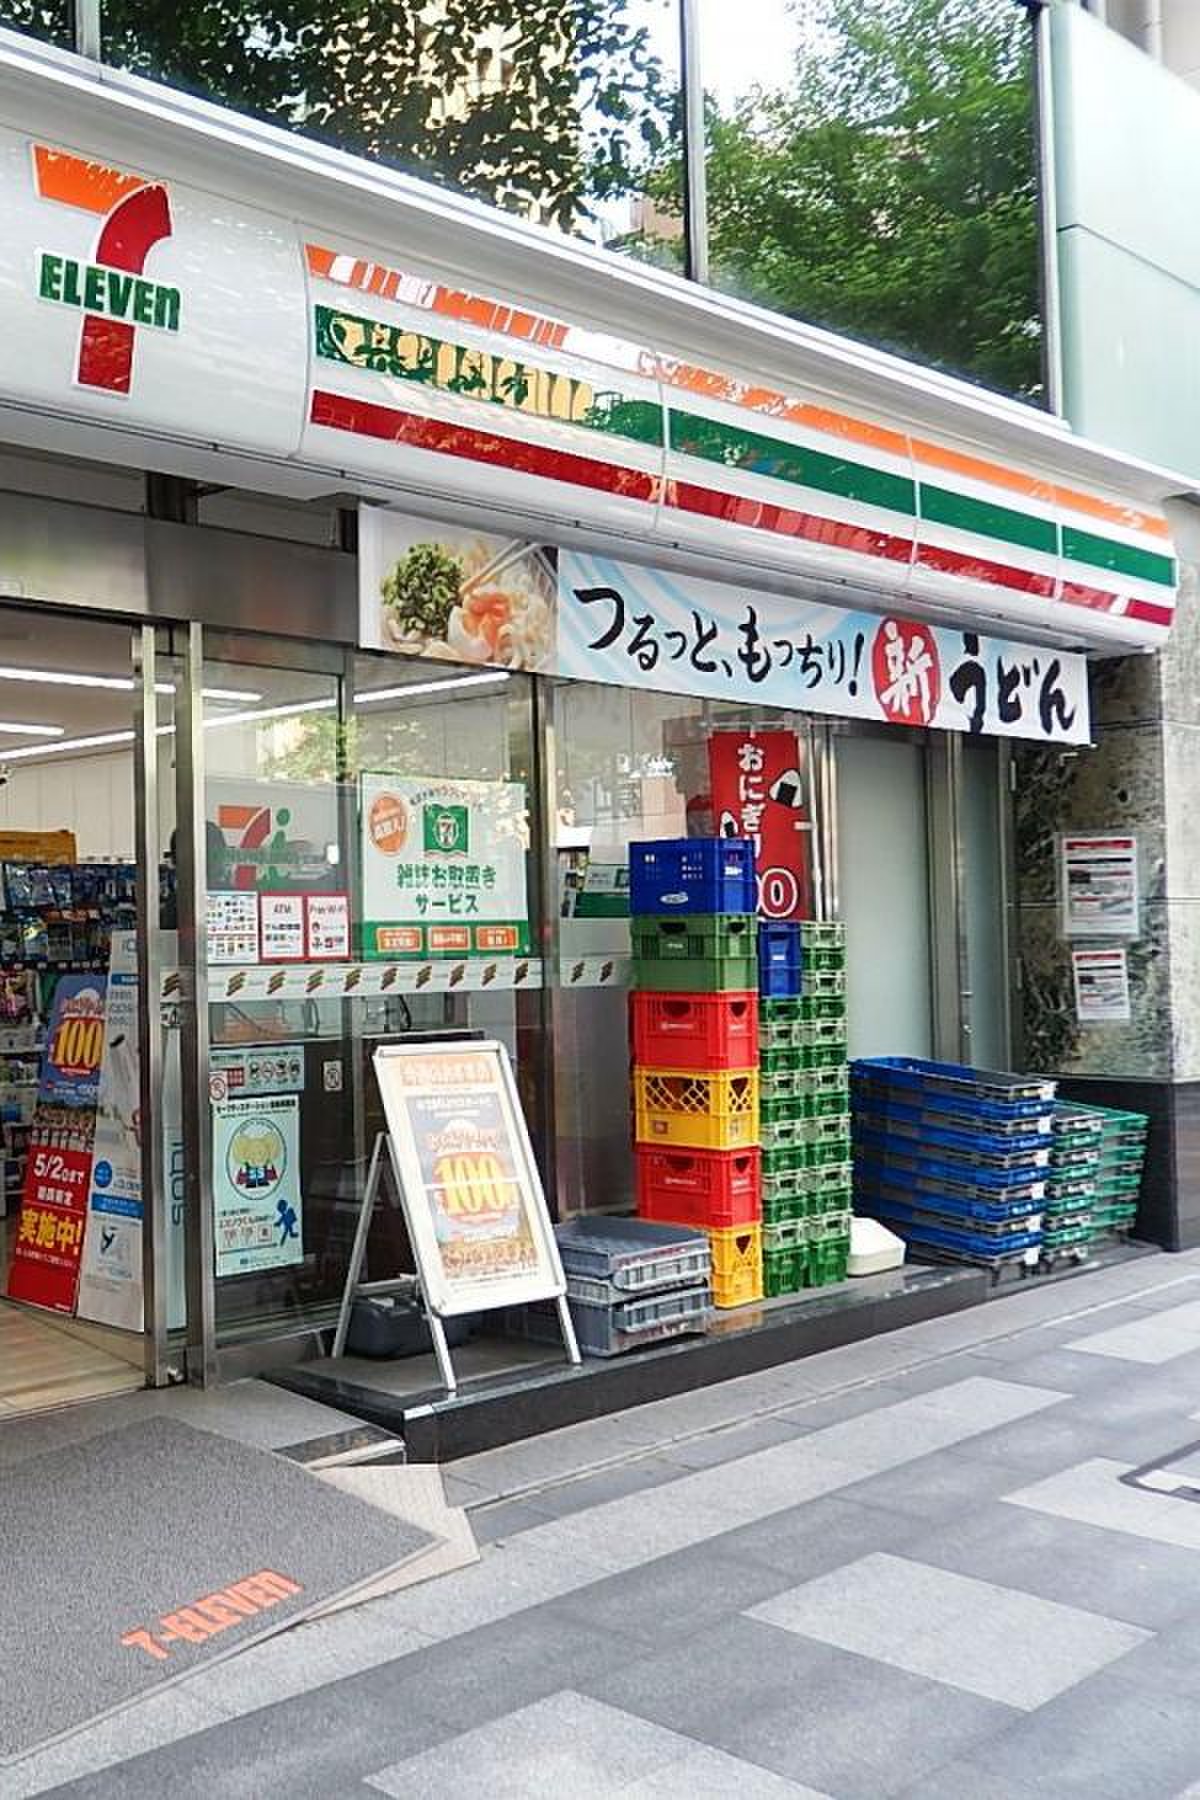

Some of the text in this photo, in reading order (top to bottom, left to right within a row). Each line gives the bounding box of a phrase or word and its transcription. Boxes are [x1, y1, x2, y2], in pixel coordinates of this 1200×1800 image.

[39, 253, 182, 332] ELEVEN
[880, 621, 934, 716] 新
[950, 634, 1078, 735] うどん
[415, 894, 480, 914] サービス
